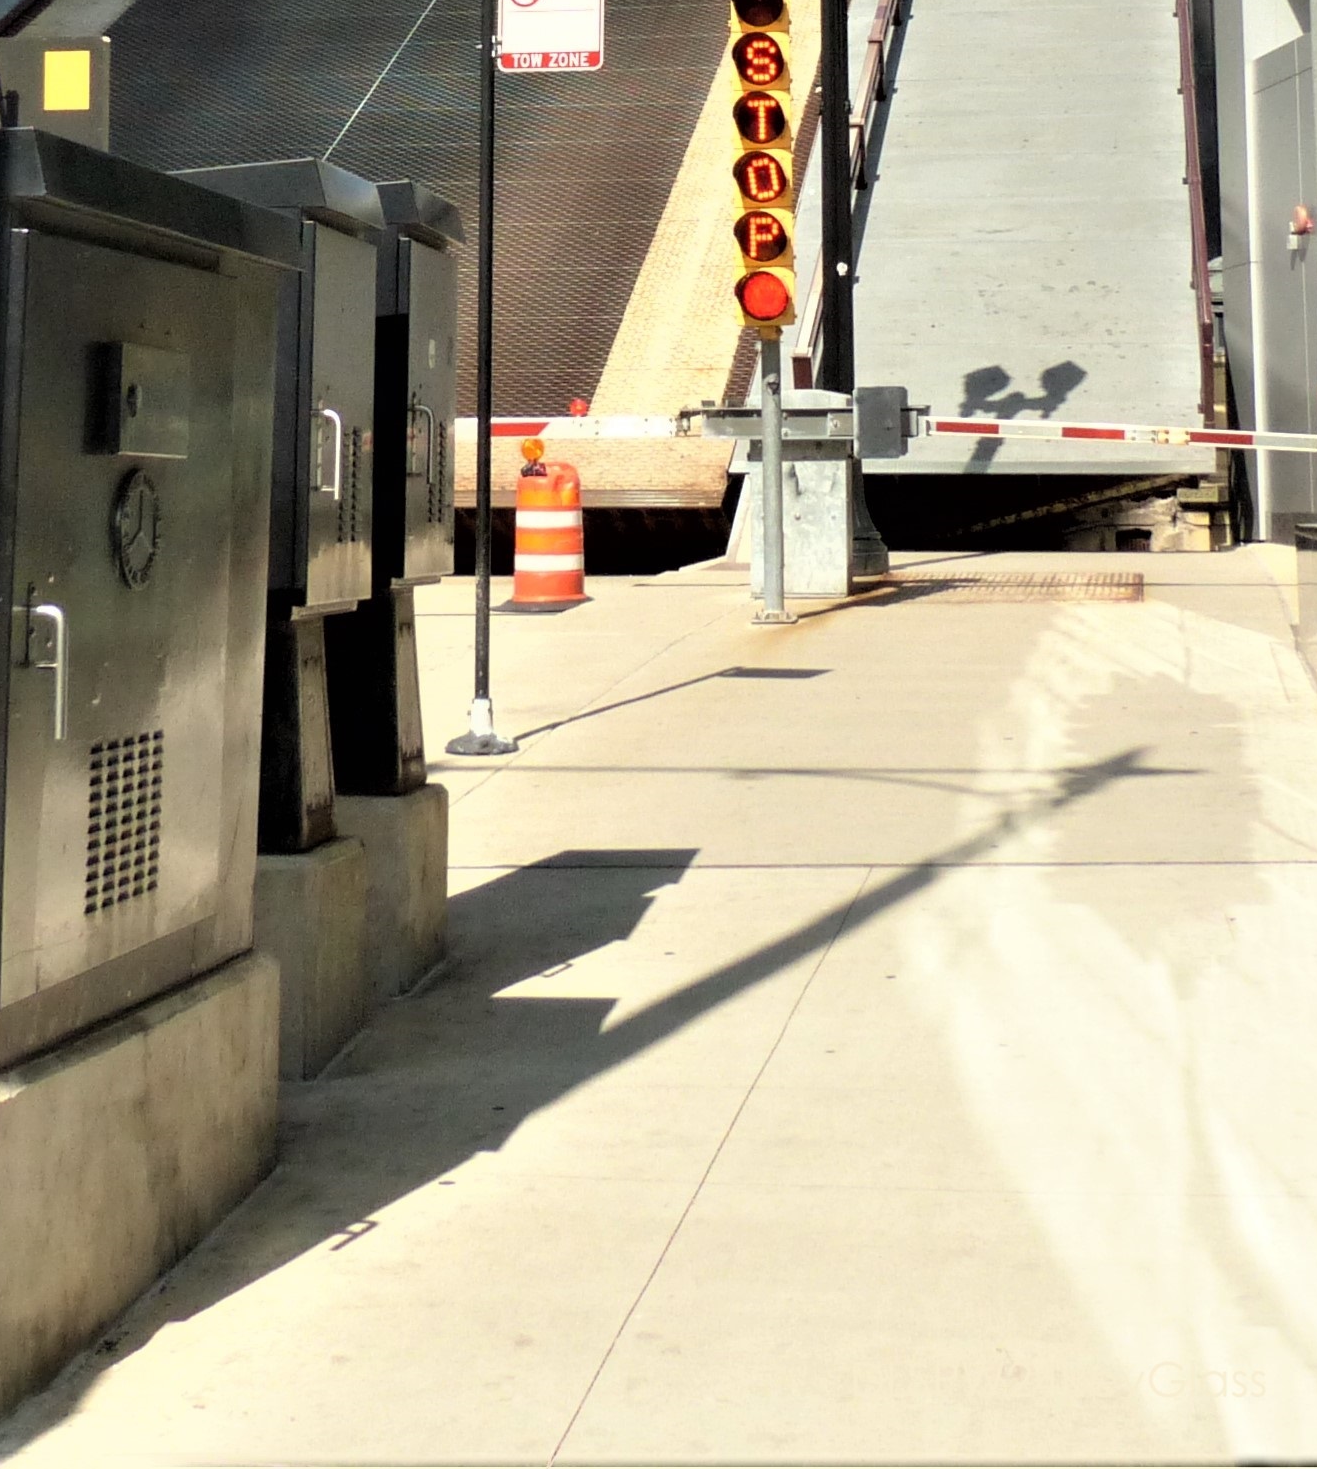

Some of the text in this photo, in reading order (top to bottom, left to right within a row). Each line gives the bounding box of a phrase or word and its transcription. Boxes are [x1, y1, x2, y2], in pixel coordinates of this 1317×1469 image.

[512, 52, 590, 68] TOW ZONE
[746, 40, 780, 258] STOP
